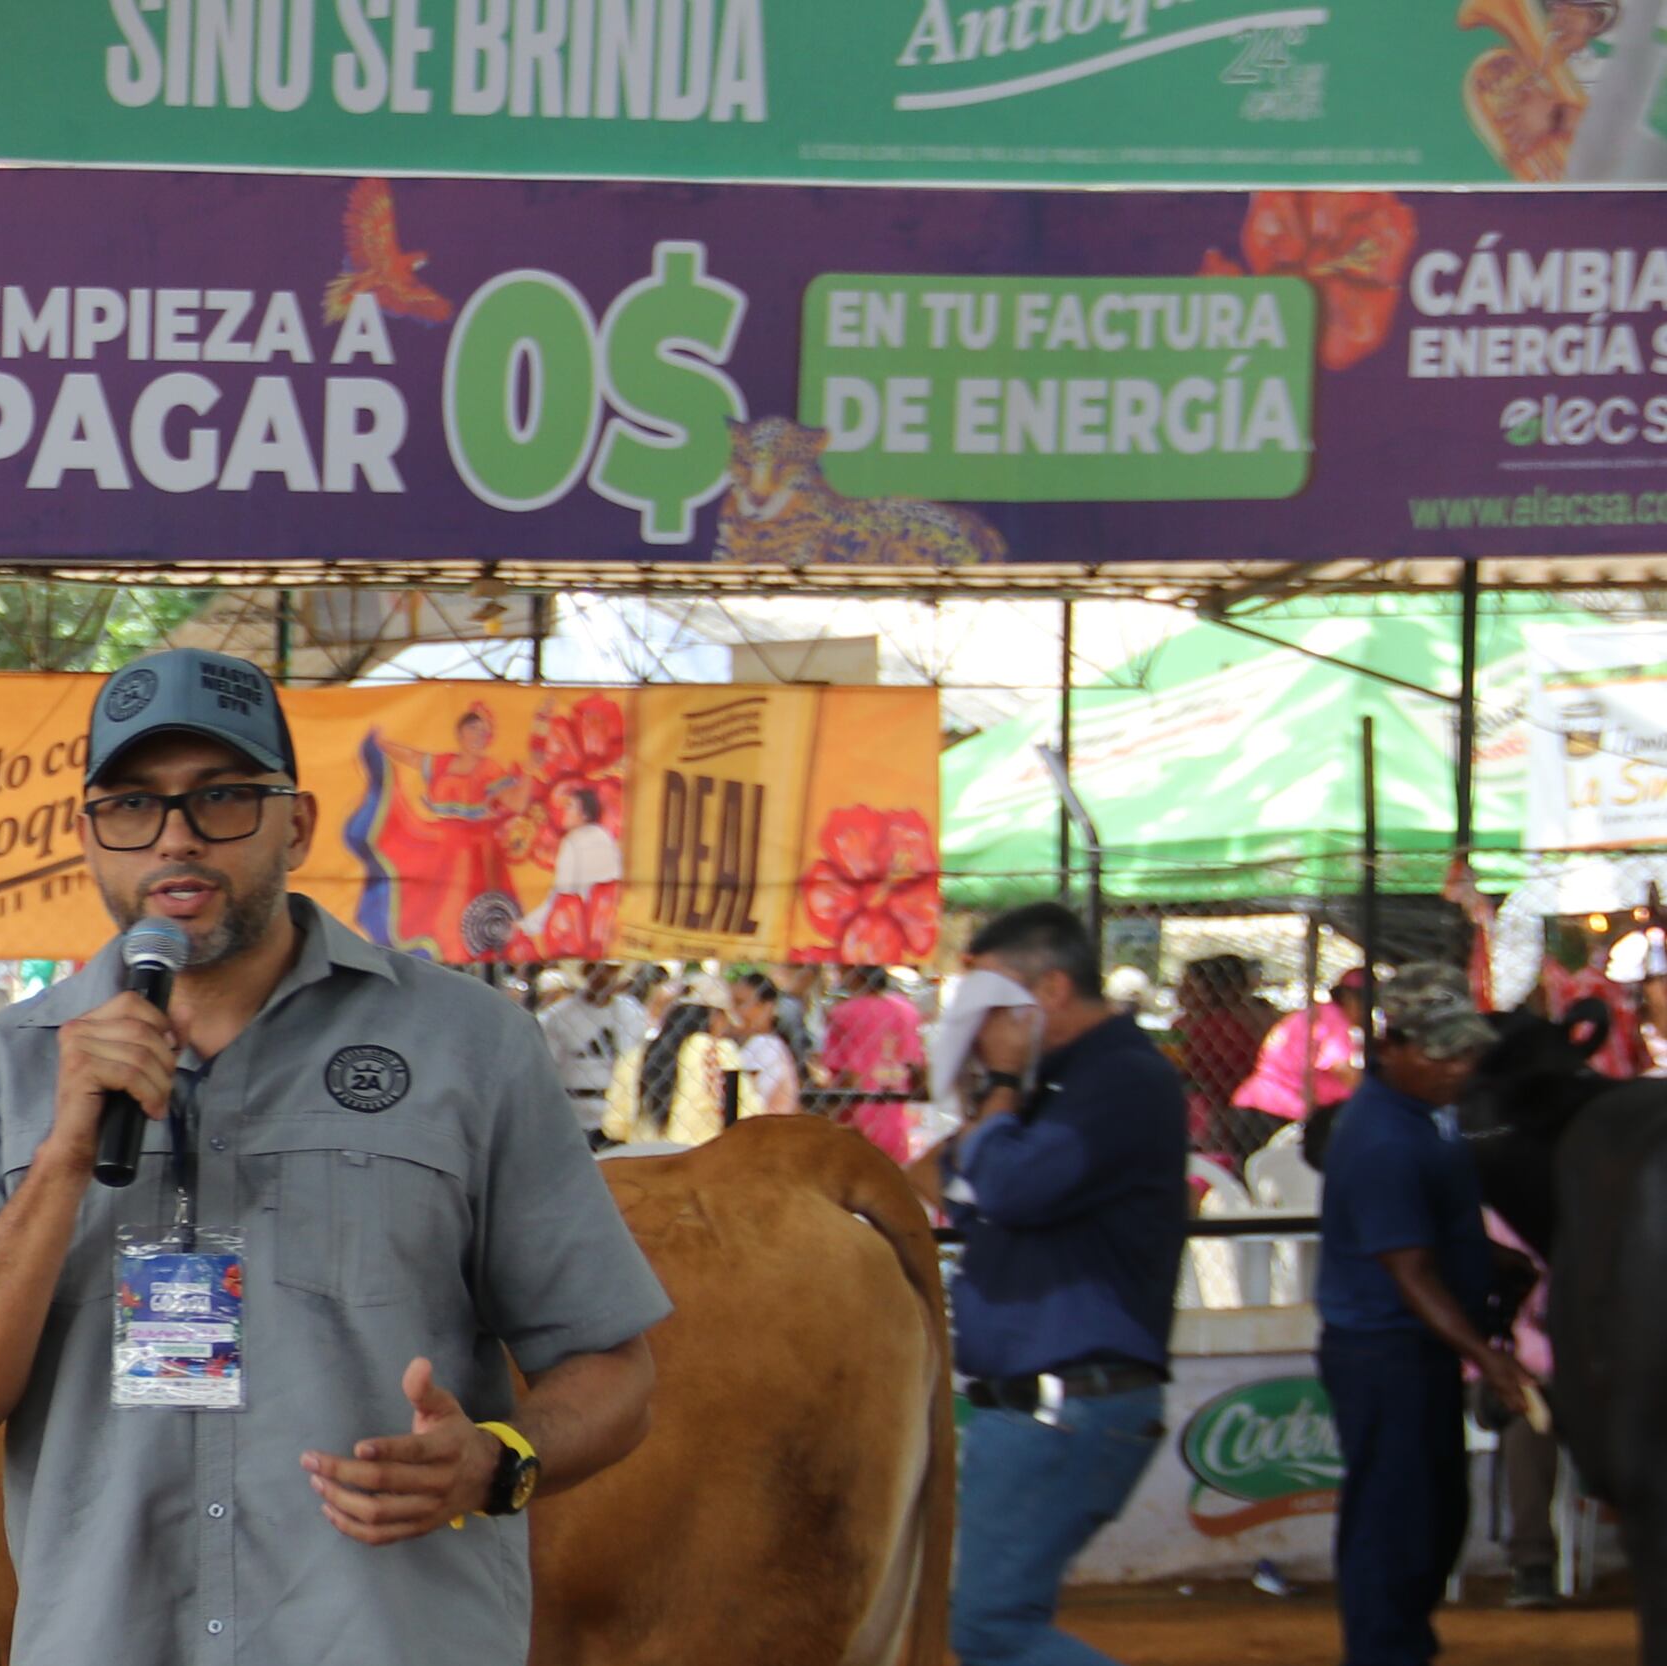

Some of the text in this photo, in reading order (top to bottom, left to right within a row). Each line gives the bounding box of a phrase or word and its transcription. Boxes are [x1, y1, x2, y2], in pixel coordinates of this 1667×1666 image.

[331, 0, 434, 115] SE
[451, 0, 769, 122] BRINDA
[331, 292, 395, 366] A
[826, 291, 1287, 351] EN TU FACTURA
[1407, 311, 1645, 378] ENERGÍA
[442, 240, 749, 545] 0$
[821, 376, 931, 455] DE
[40, 733, 89, 776] co
[651, 768, 765, 937] REAL
[350, 1074, 384, 1091] 2A
